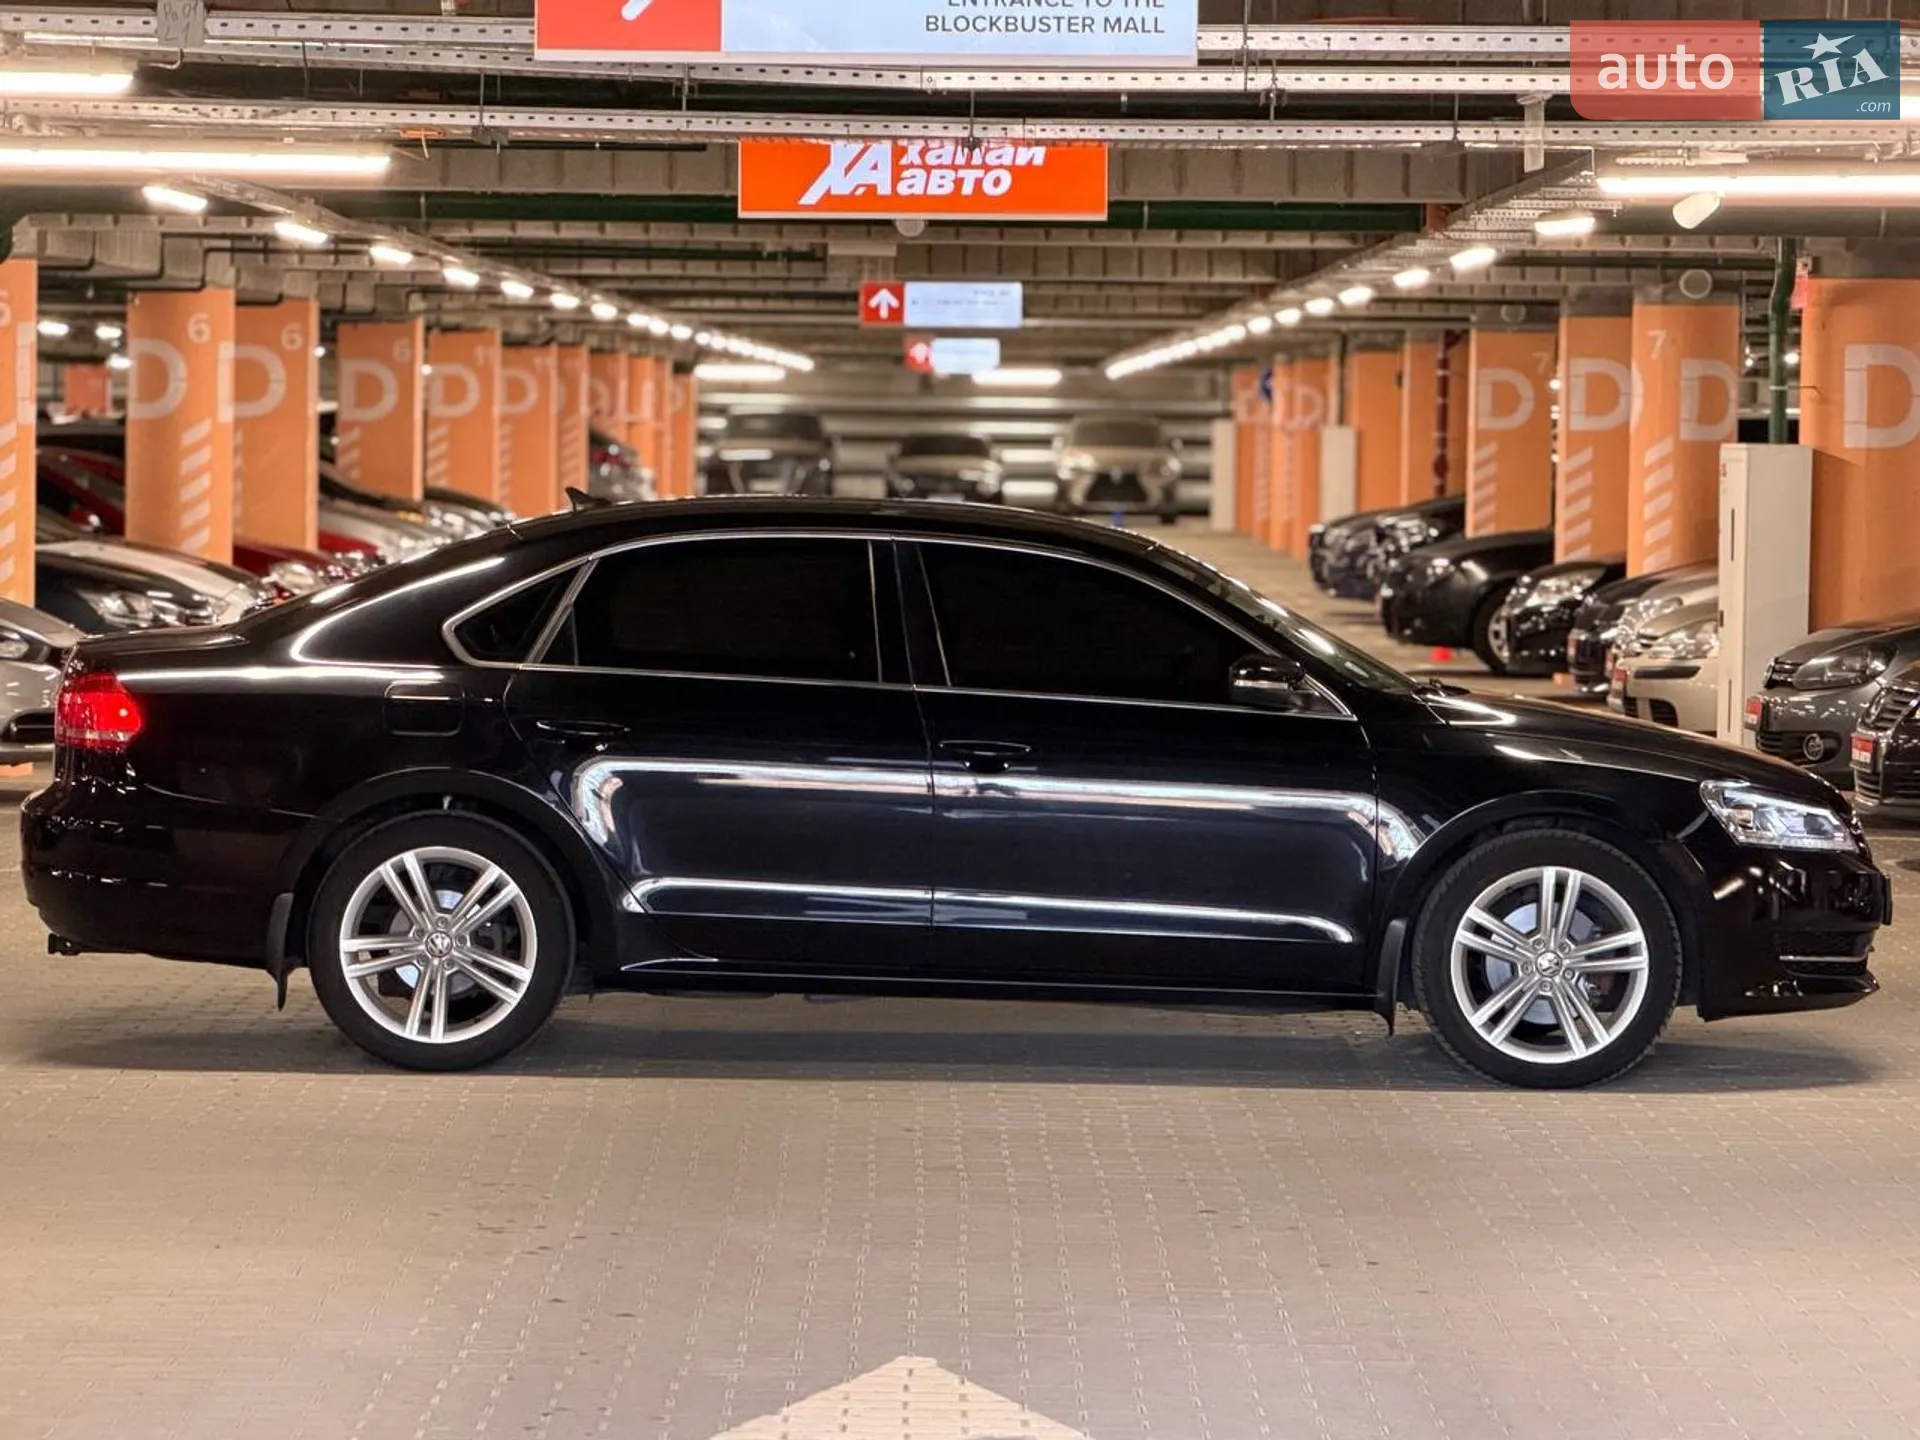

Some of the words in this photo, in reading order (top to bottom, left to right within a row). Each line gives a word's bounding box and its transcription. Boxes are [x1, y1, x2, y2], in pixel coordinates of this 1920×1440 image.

[925, 15, 1095, 33] BLOCKBUSTER
[1103, 16, 1165, 33] MALL
[896, 168, 1012, 196] авто
[187, 313, 212, 344] 6
[281, 323, 303, 351] 6
[1645, 329, 1666, 360] 7
[128, 338, 188, 419] D
[217, 340, 287, 422] D
[339, 358, 398, 421] D
[427, 363, 480, 418] D
[1477, 367, 1536, 430] D
[1568, 356, 1644, 432] D
[1843, 343, 1920, 448] D
